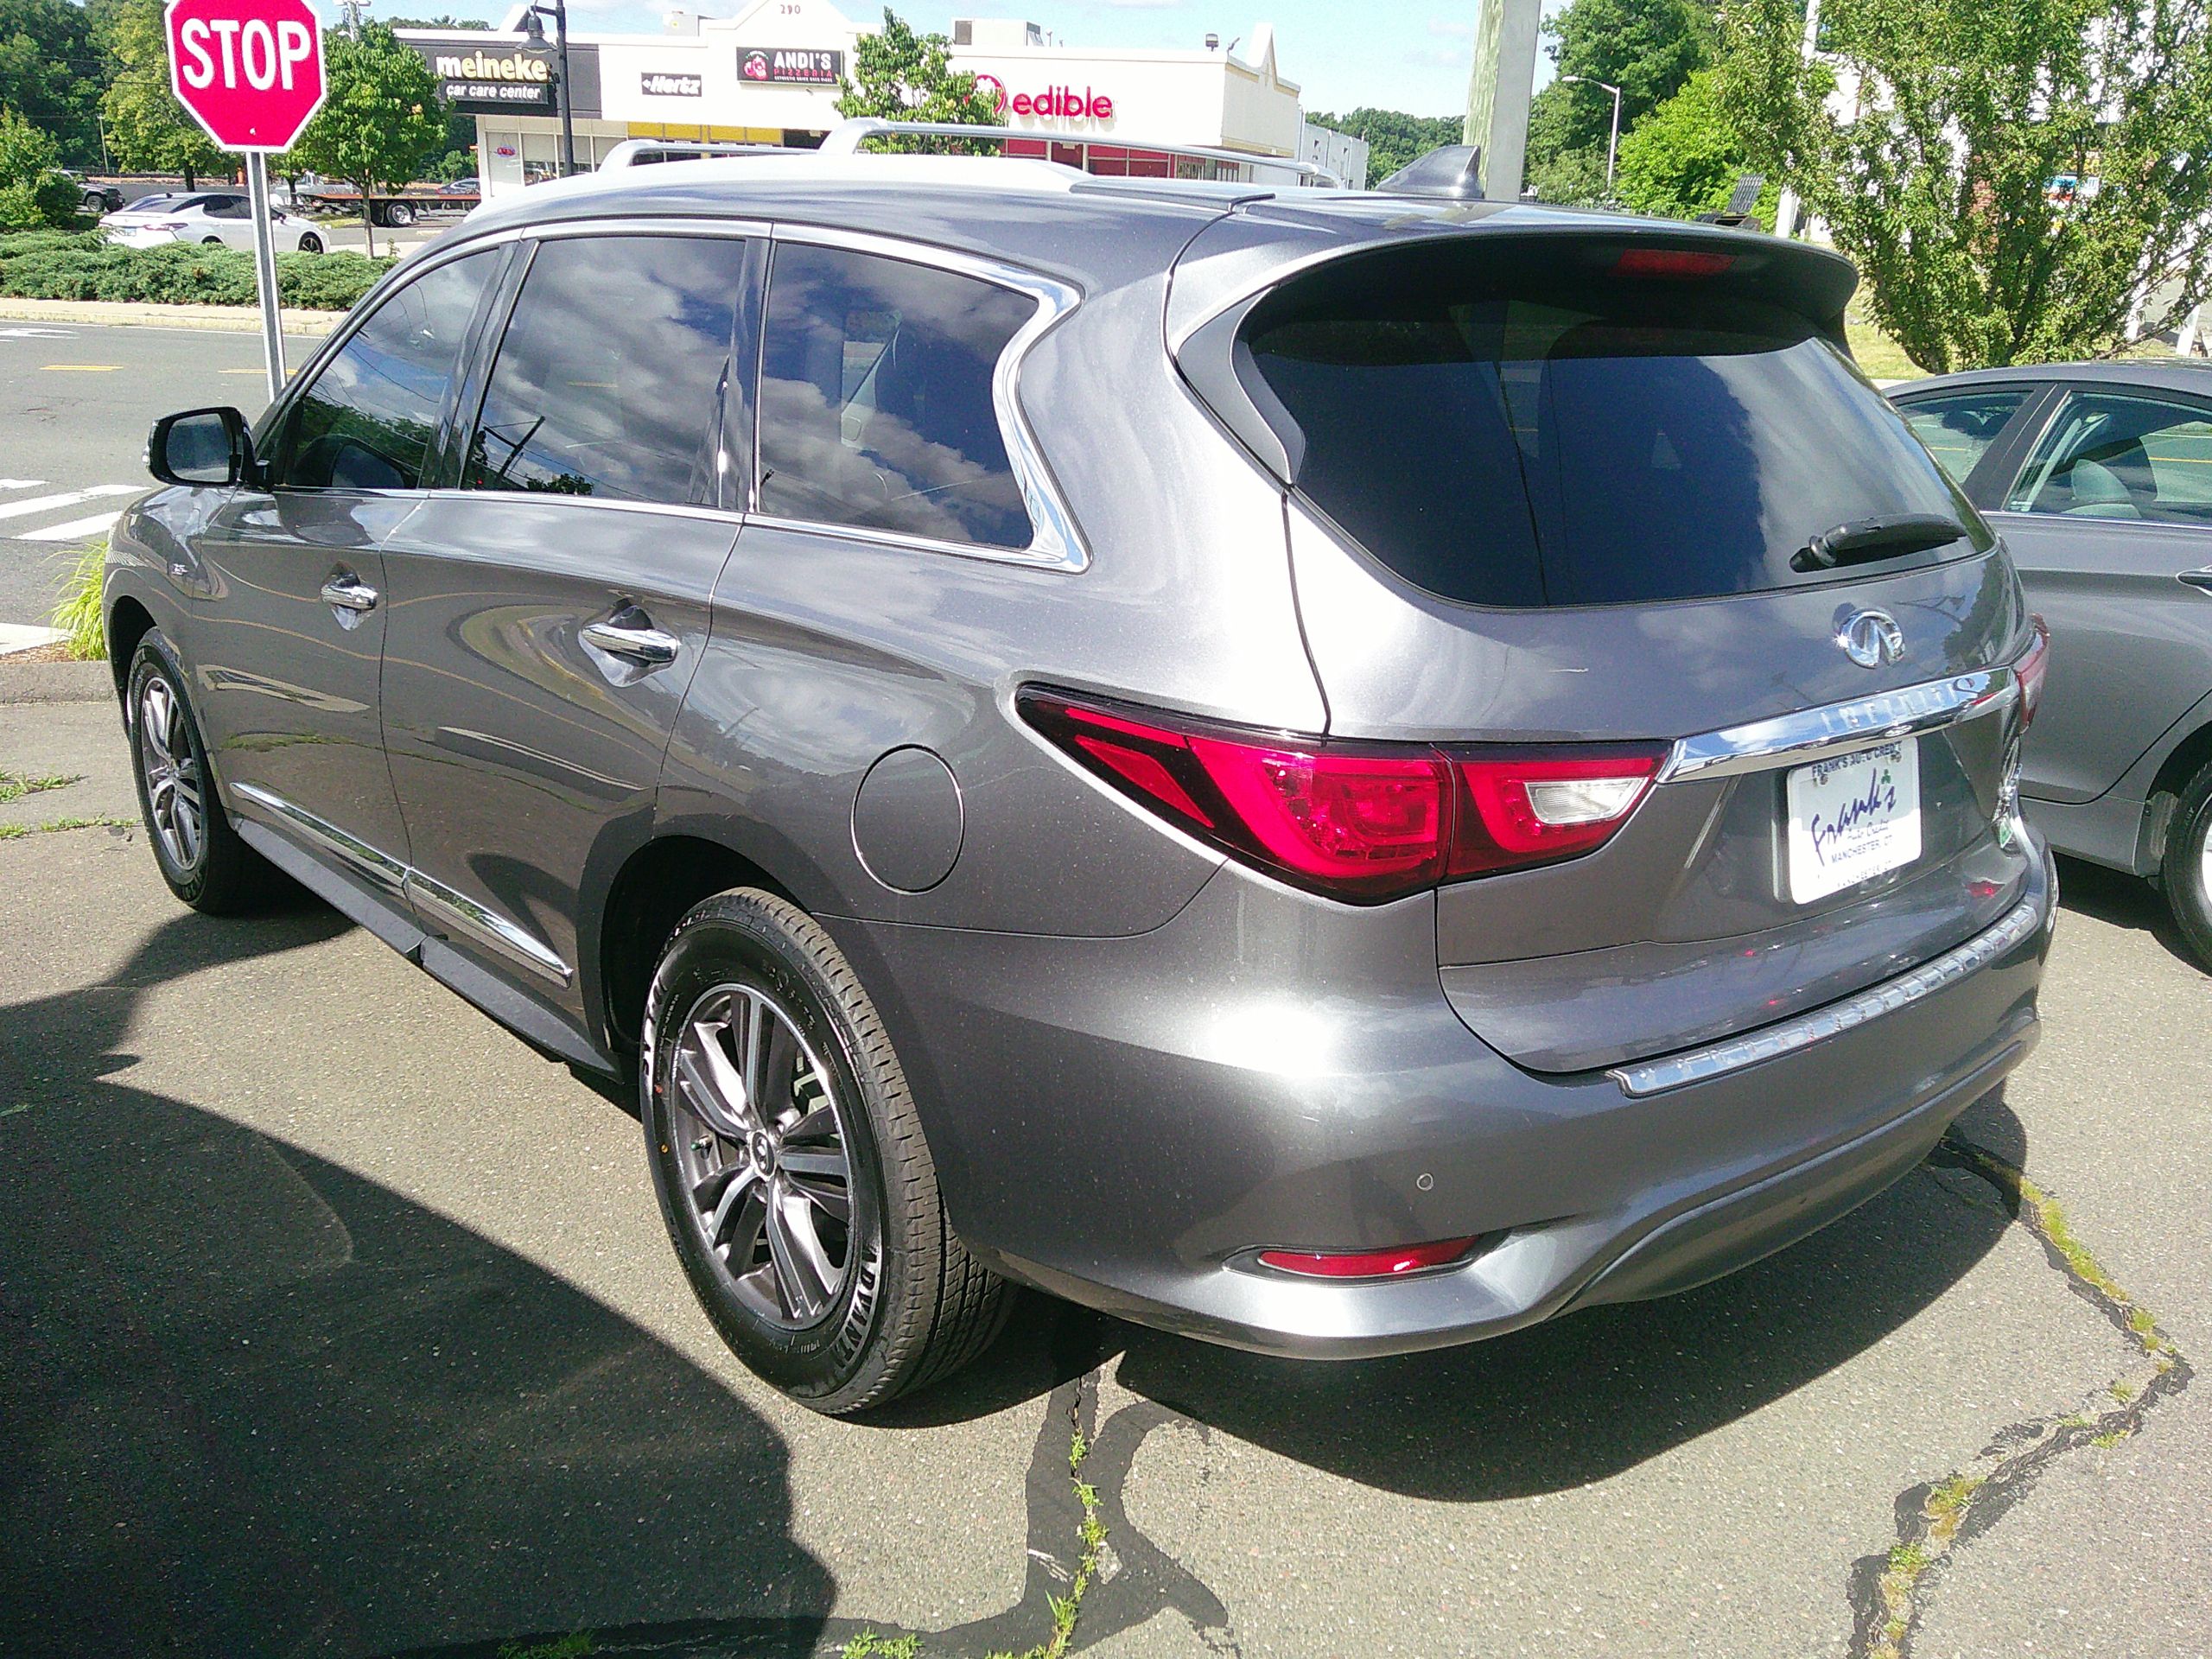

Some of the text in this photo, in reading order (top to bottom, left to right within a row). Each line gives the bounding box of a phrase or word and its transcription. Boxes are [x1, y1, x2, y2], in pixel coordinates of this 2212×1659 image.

[181, 17, 311, 91] STOP
[773, 51, 832, 71] ANDI'S
[435, 50, 548, 81] meineke
[774, 68, 833, 78] PIZZERIA
[446, 85, 541, 100] car care center
[649, 75, 701, 95] Hertz
[1012, 85, 1113, 118] edible
